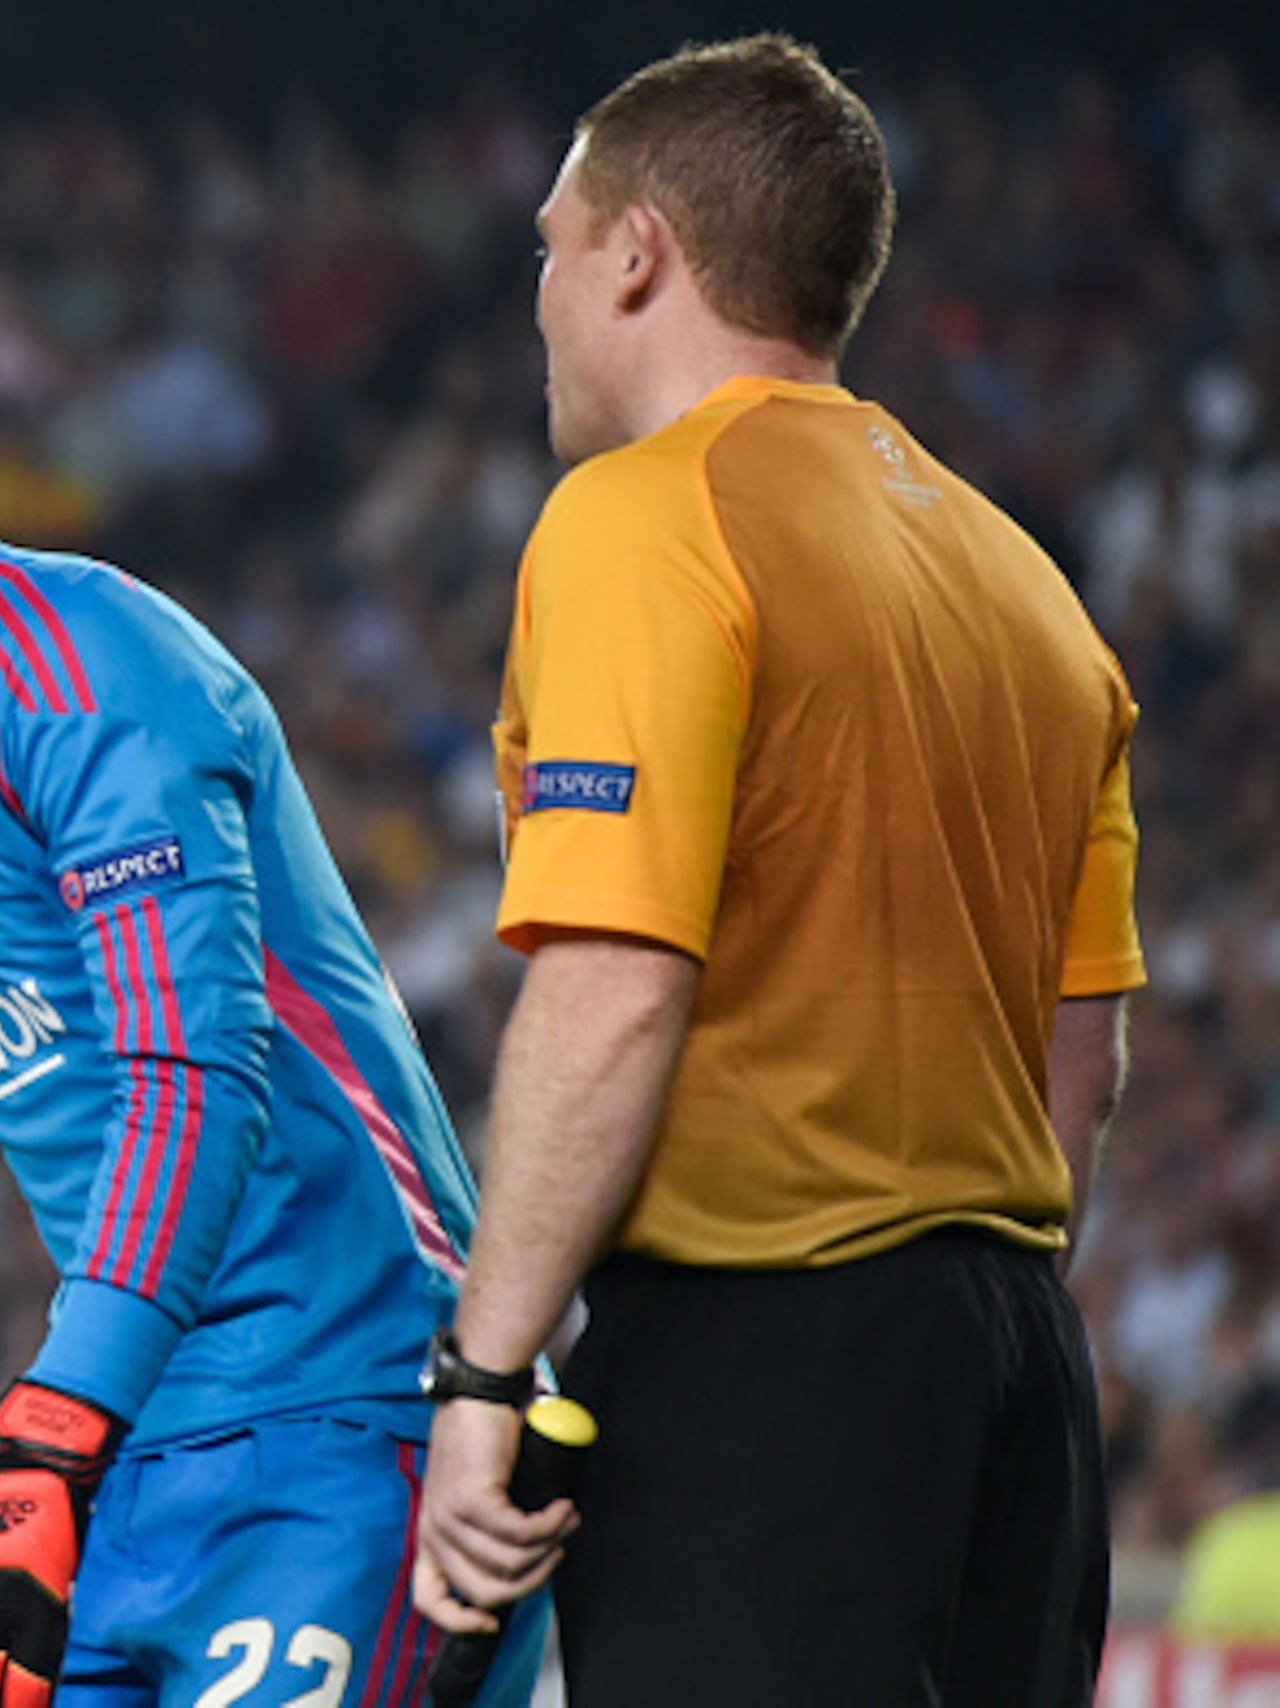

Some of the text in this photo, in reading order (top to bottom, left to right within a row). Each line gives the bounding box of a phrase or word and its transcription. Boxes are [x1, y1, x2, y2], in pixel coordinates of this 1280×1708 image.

[537, 771, 633, 801] RESPECT
[84, 844, 180, 893] RESPECT
[193, 1616, 353, 1708] 22
